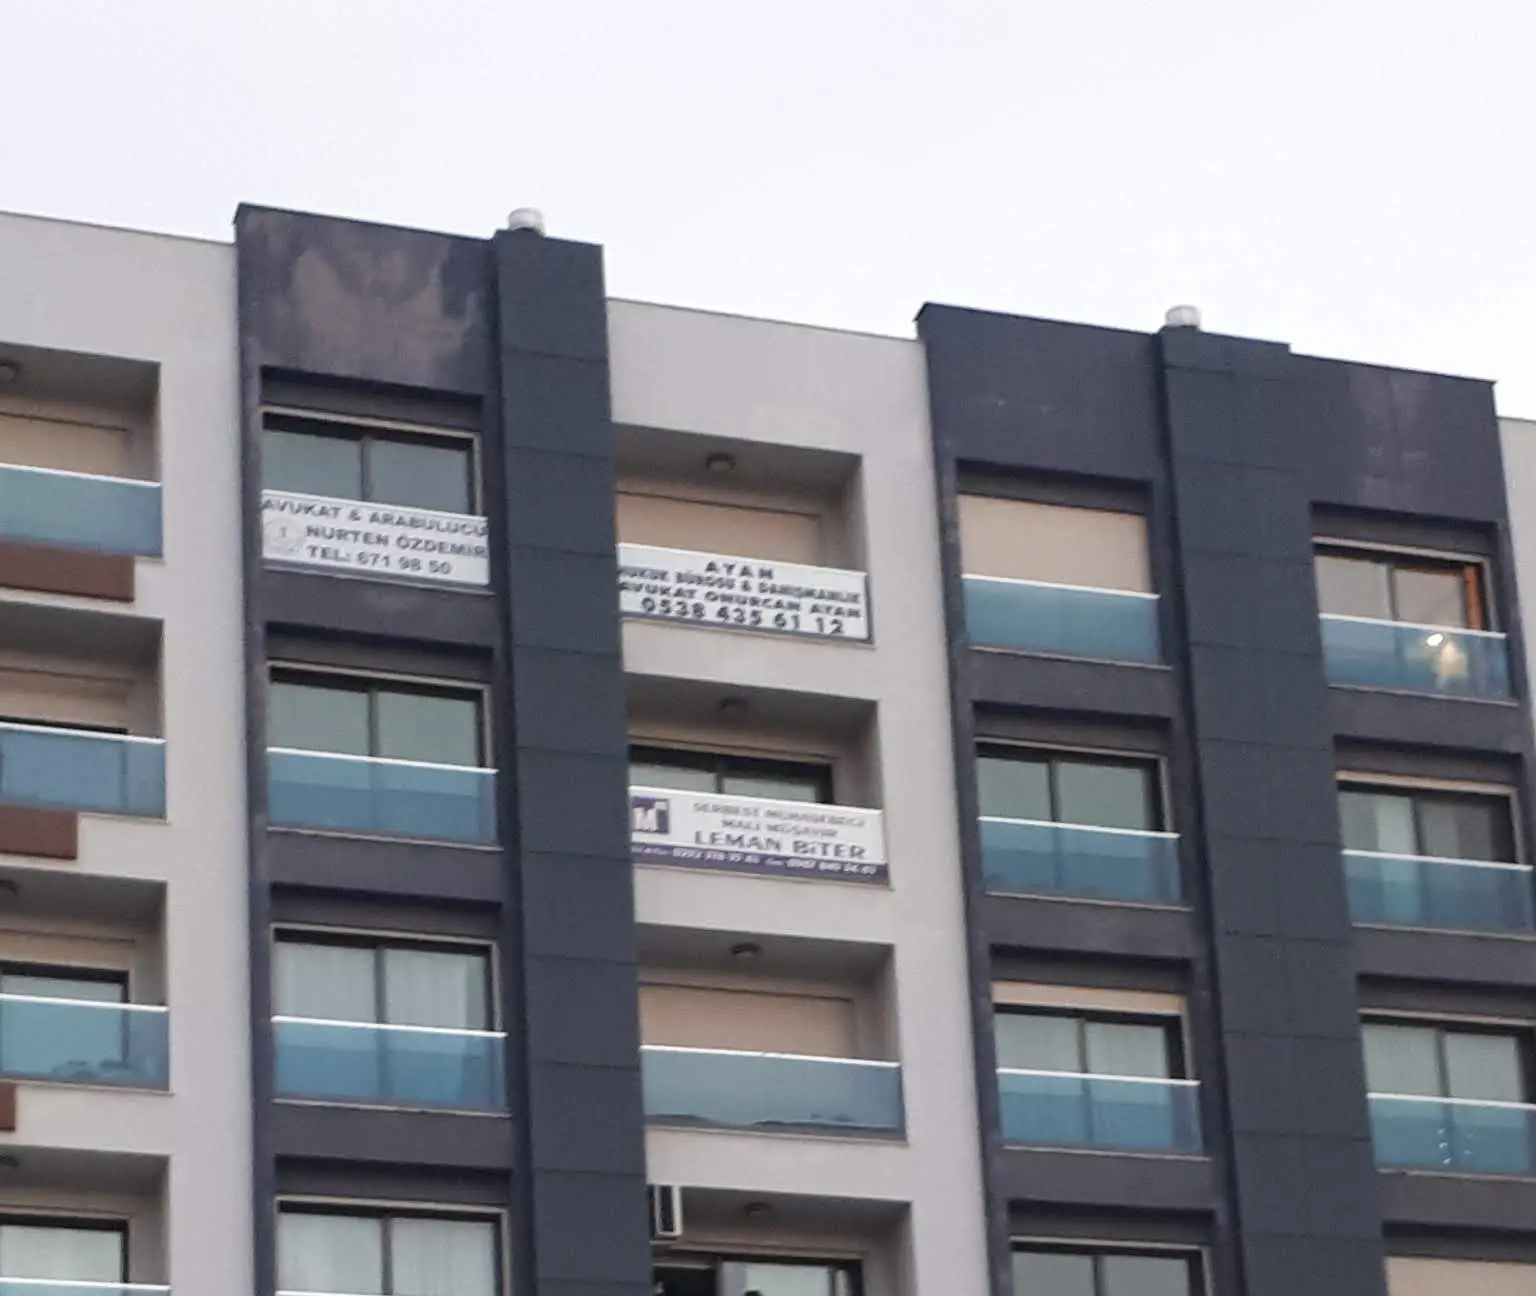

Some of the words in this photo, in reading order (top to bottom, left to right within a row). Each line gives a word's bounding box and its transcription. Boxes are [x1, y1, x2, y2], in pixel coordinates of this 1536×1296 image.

[263, 499, 341, 520] AVUKAT
[349, 508, 361, 522] &
[369, 512, 487, 537] ARABULUCU
[306, 525, 389, 546] NURTEN
[705, 561, 773, 579] AYAN
[617, 581, 696, 599] AVUKAT
[815, 616, 844, 635] 12
[694, 830, 781, 852] LEMAN
